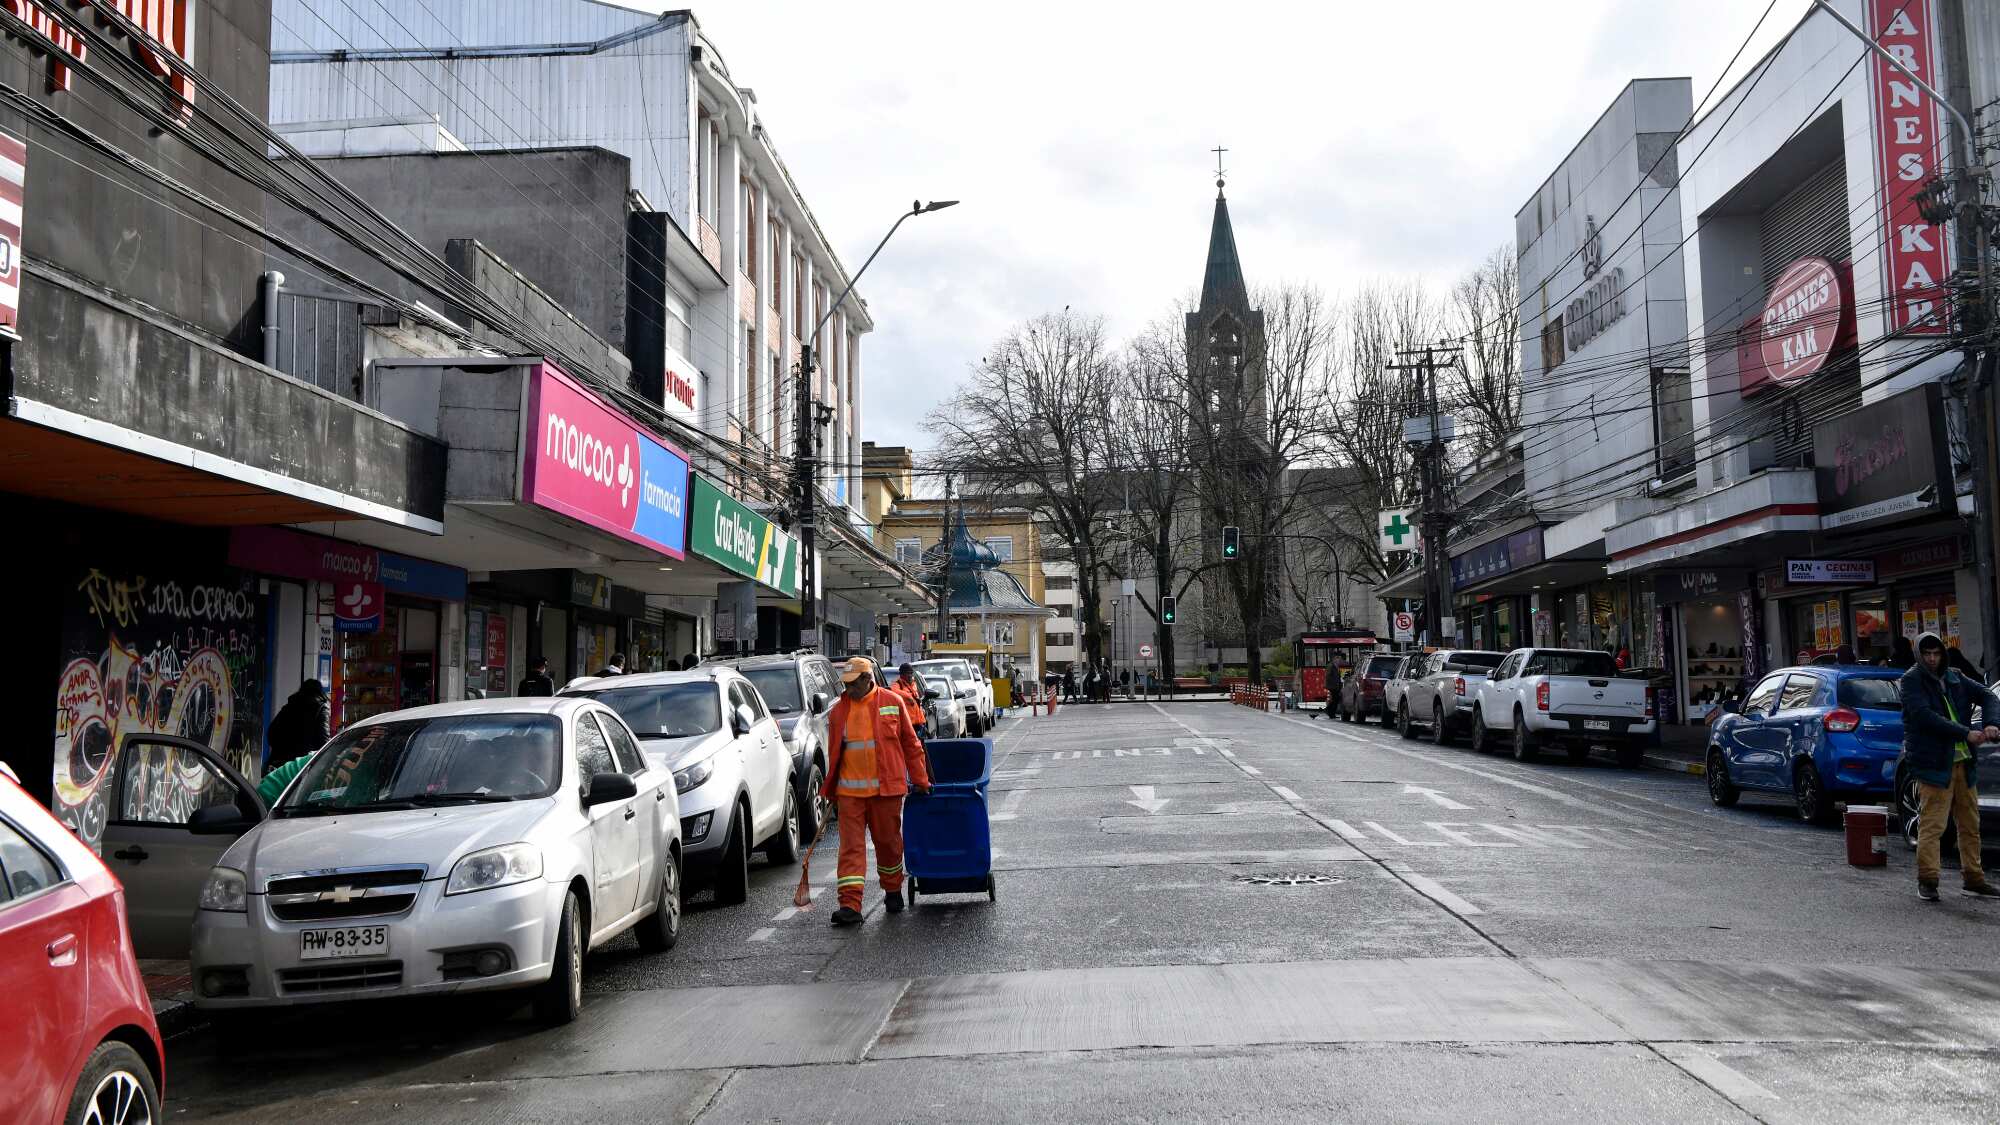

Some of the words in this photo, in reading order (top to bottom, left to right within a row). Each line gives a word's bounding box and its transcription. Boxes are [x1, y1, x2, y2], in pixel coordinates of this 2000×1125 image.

[1766, 272, 1829, 336] CARNES
[1781, 326, 1818, 370] KAR
[546, 413, 614, 488] maicao
[644, 470, 680, 519] farmacia
[714, 499, 733, 553] Cruz
[733, 511, 756, 565] Verde
[321, 551, 361, 574] maicao
[1791, 563, 1812, 572] PAN
[1825, 563, 1872, 572] CECINAS
[339, 620, 373, 630] farmacia
